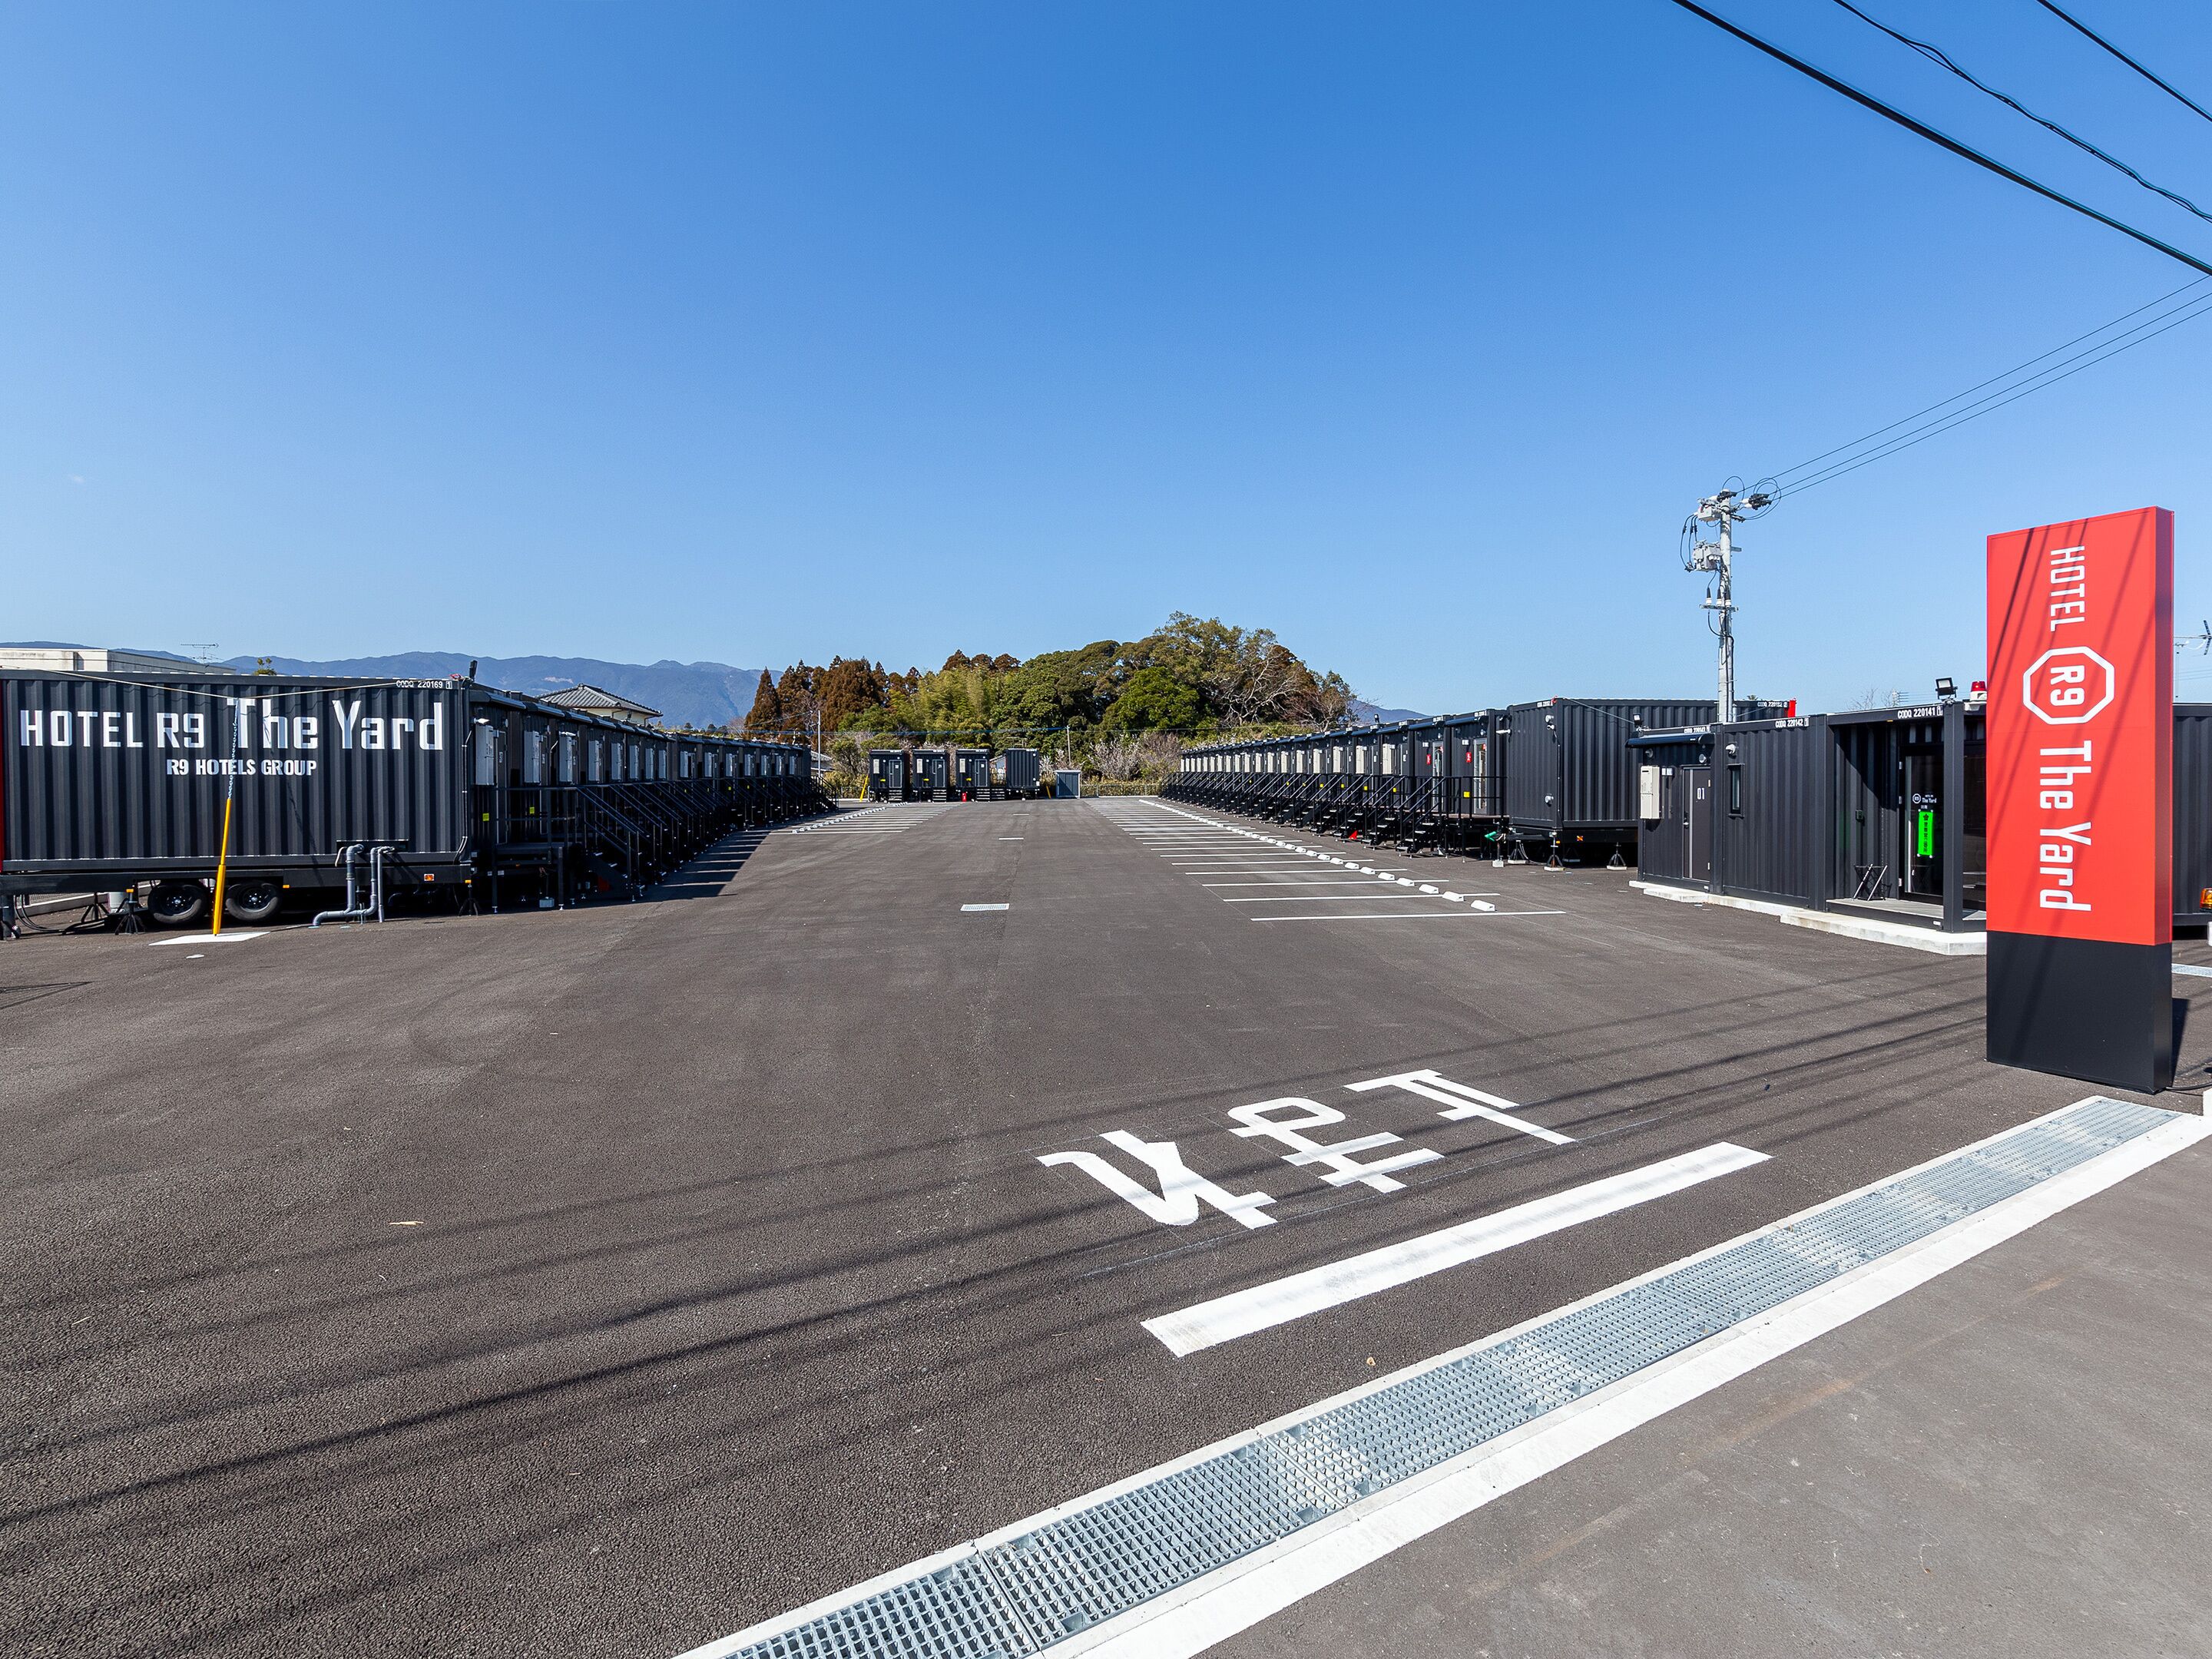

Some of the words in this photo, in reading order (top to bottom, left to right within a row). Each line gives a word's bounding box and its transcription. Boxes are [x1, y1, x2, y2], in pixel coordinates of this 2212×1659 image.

[2050, 545, 2085, 631] HOTEL
[417, 680, 443, 689] 220169
[2050, 665, 2085, 706] R9
[20, 710, 144, 748] HOTEL
[157, 712, 205, 748] R9
[227, 698, 318, 750] The
[332, 700, 443, 750] Yard
[1913, 707, 1936, 717] 220141
[167, 759, 190, 775] R9
[196, 759, 256, 776] HOTELS
[261, 759, 317, 776] GROUP
[2040, 740, 2091, 810] The
[1697, 787, 1705, 800] 01
[2039, 822, 2091, 912] Yard
[1037, 1069, 1575, 1229] 止まれ
